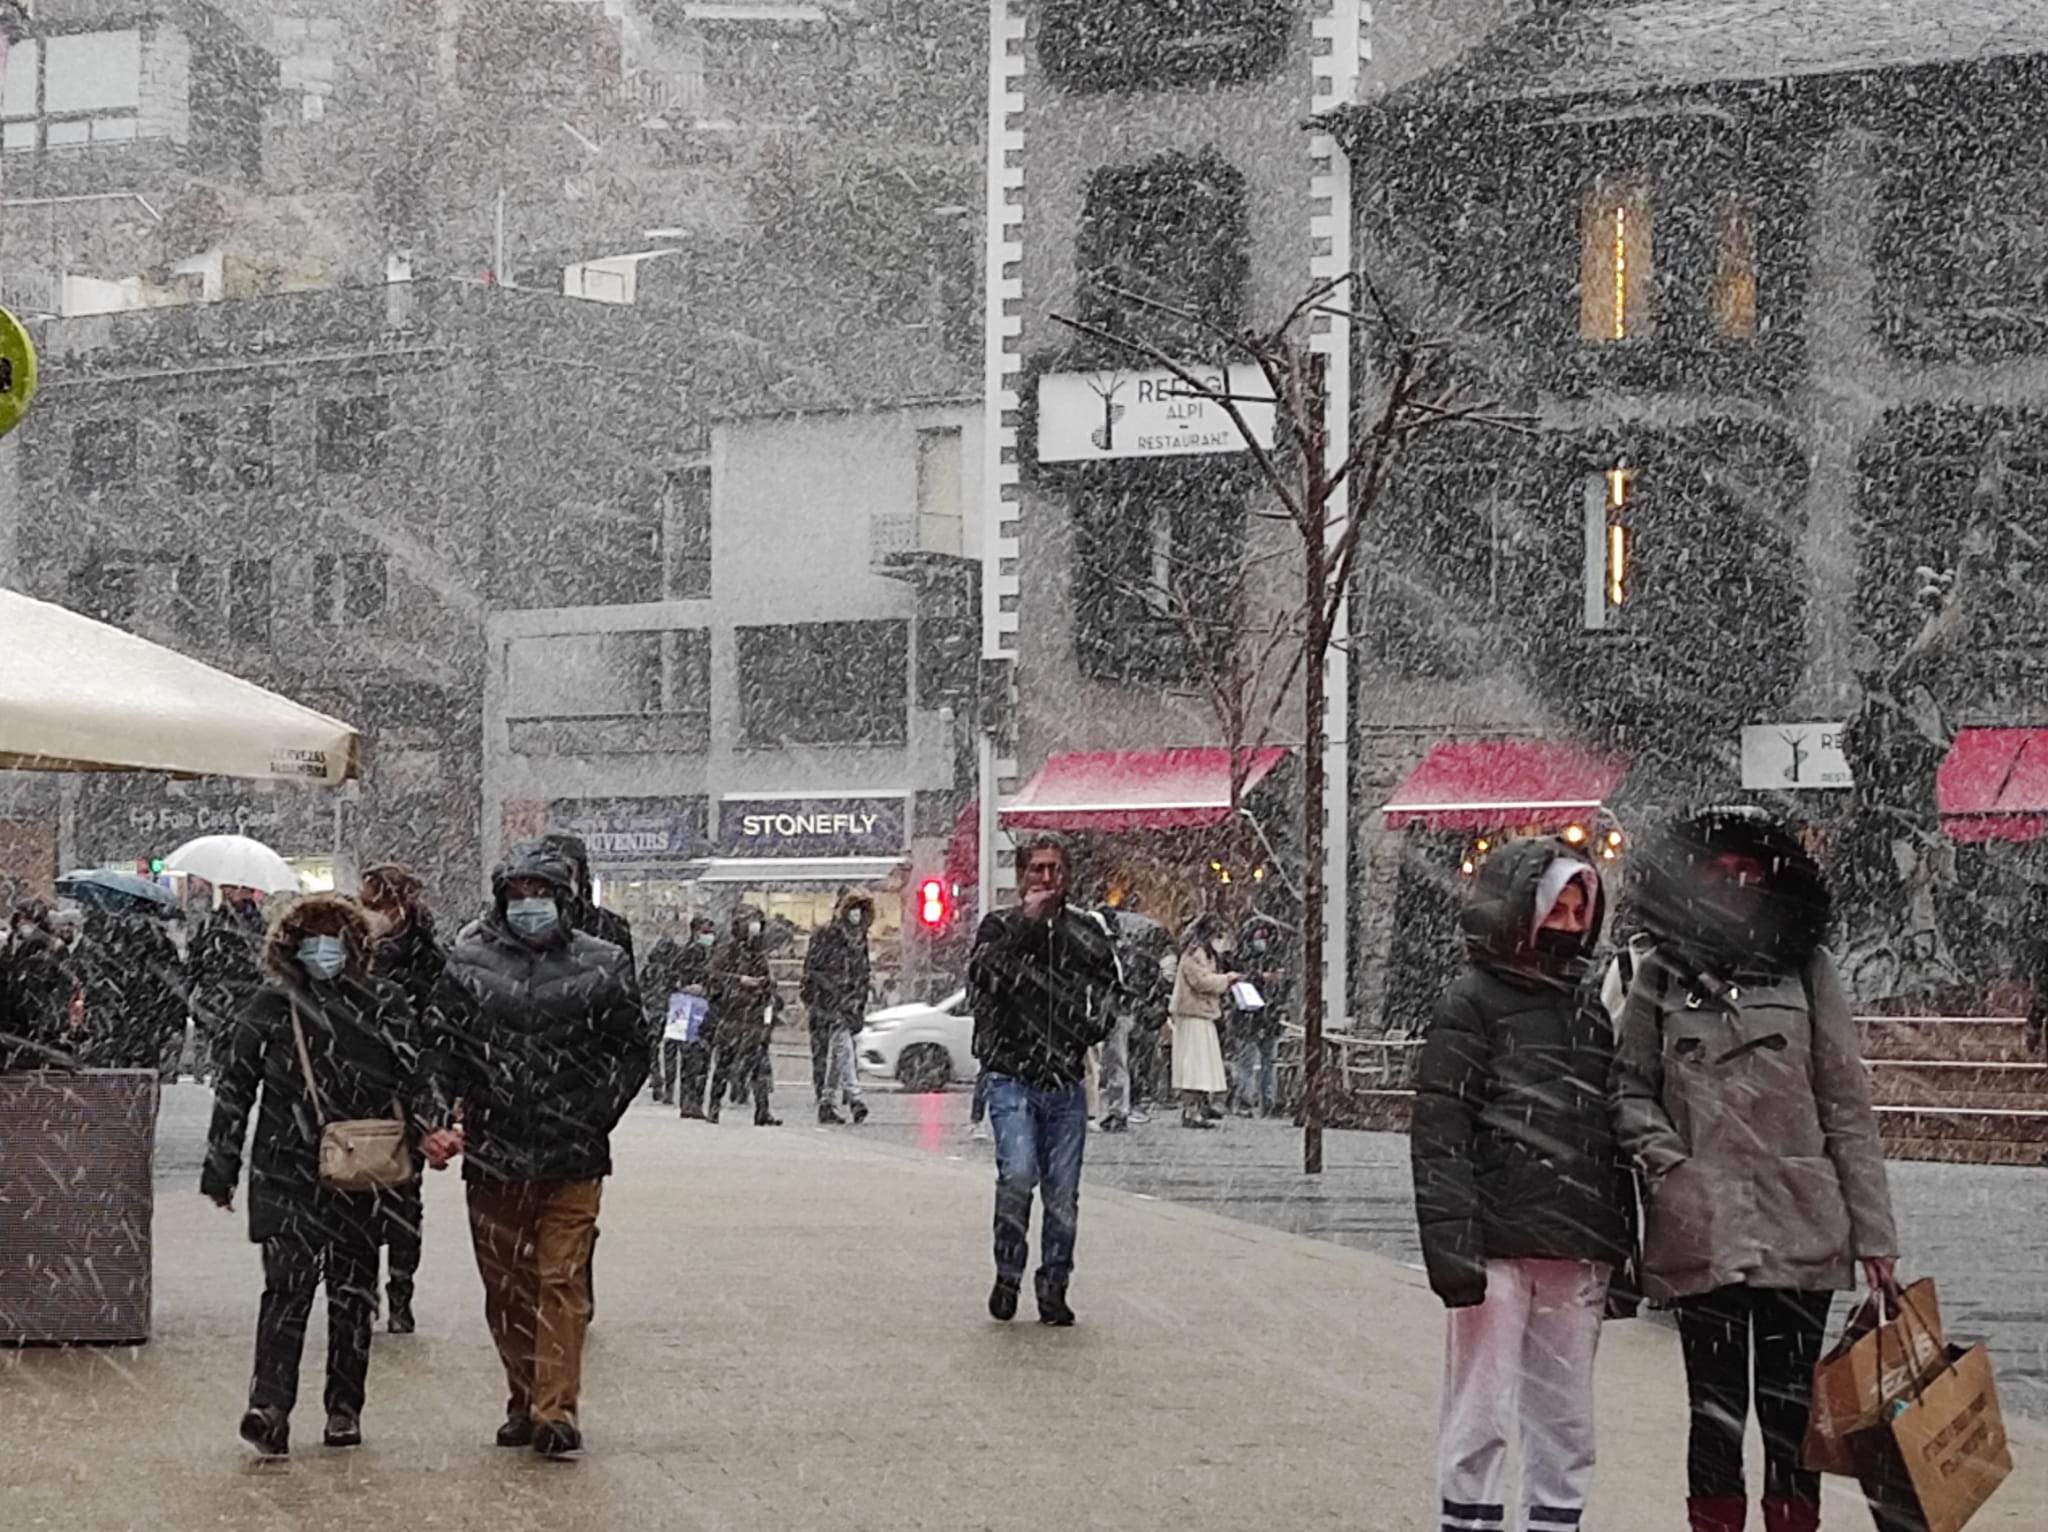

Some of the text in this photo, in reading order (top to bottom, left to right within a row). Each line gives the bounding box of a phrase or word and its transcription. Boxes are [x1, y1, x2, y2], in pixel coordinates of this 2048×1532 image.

[1167, 403, 1203, 419] ALPI
[1137, 431, 1229, 449] RESTAURANT
[743, 812, 878, 836] STONEFLY
